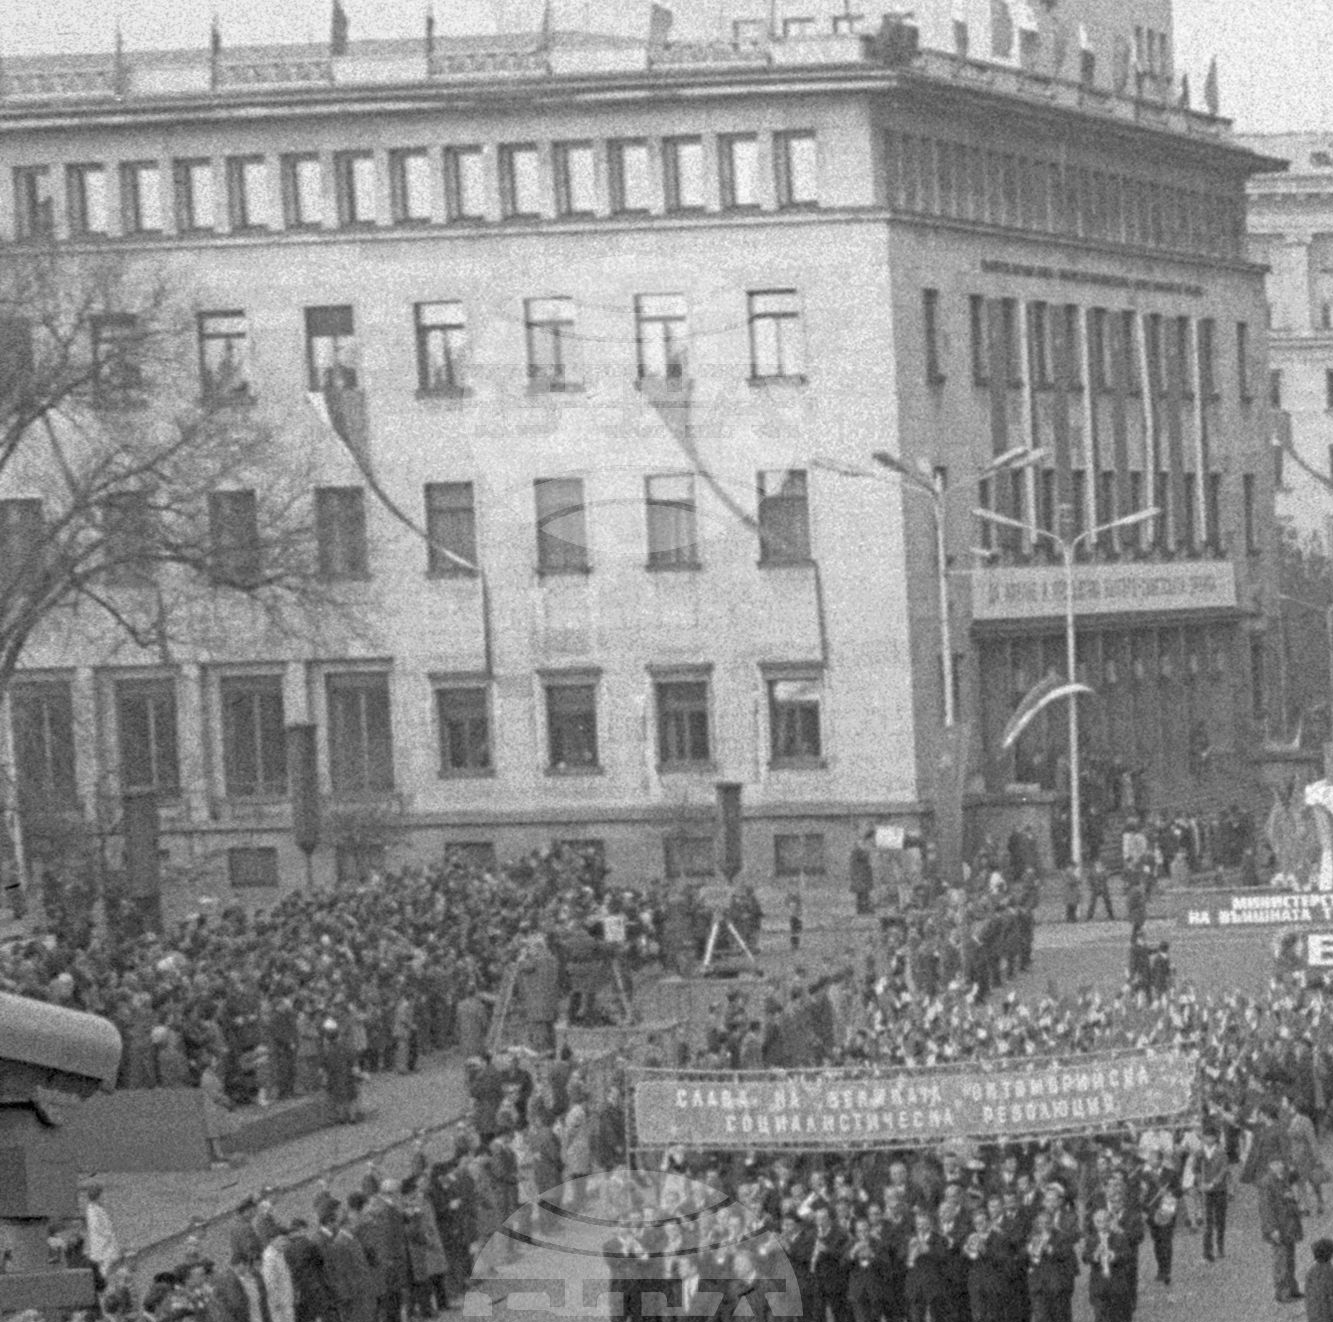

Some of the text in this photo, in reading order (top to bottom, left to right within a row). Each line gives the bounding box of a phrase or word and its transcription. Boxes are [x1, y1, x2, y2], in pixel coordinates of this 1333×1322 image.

[1187, 909, 1211, 924] НА
[725, 1091, 1115, 1135] СОЦИАЛИСТИЧЕСКА РЕВОЛЮЦИЯ
